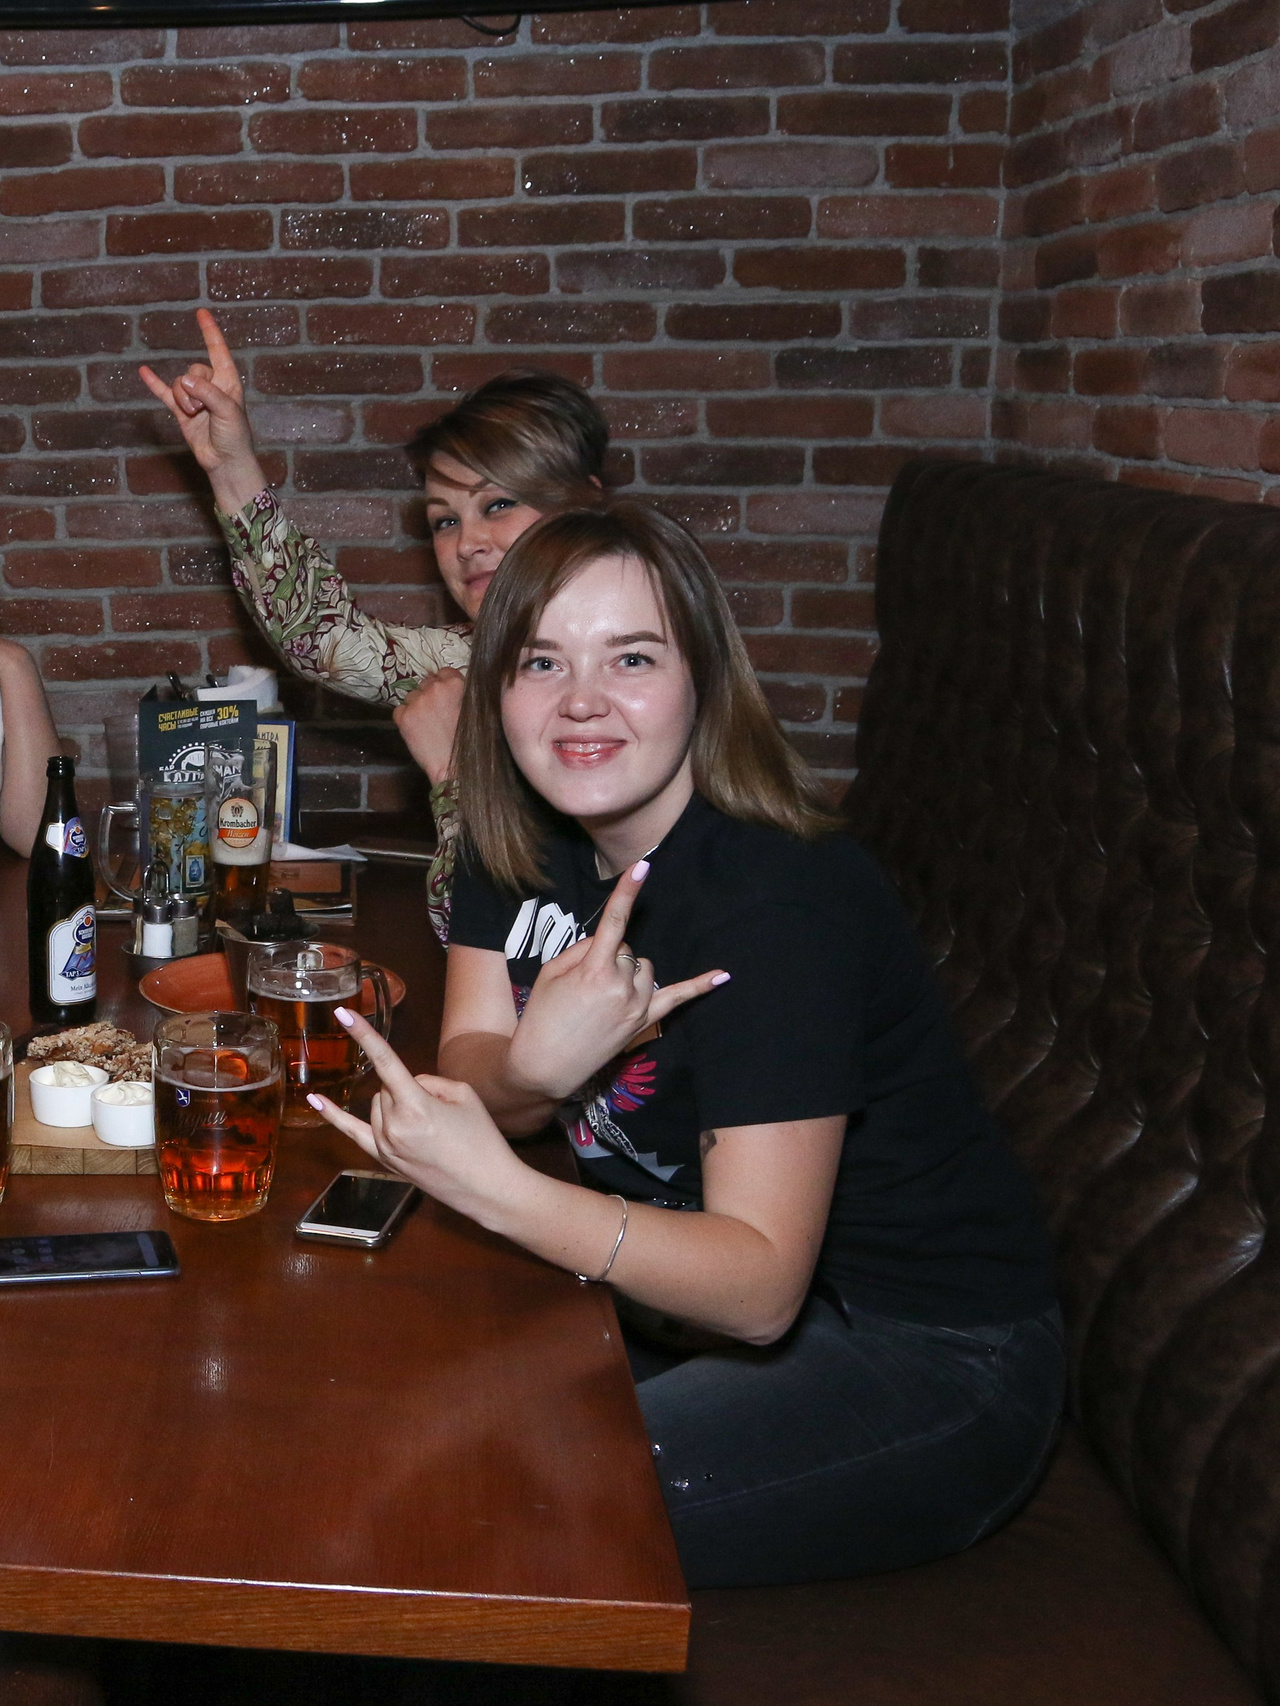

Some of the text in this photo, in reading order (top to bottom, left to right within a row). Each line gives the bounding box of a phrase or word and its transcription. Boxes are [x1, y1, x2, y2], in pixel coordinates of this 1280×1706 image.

[158, 707, 199, 723] СЧАСТЛИВЫЕ
[217, 704, 239, 720] 30%
[158, 720, 177, 732] ЧАСЫ
[219, 818, 257, 828] Krombacher
